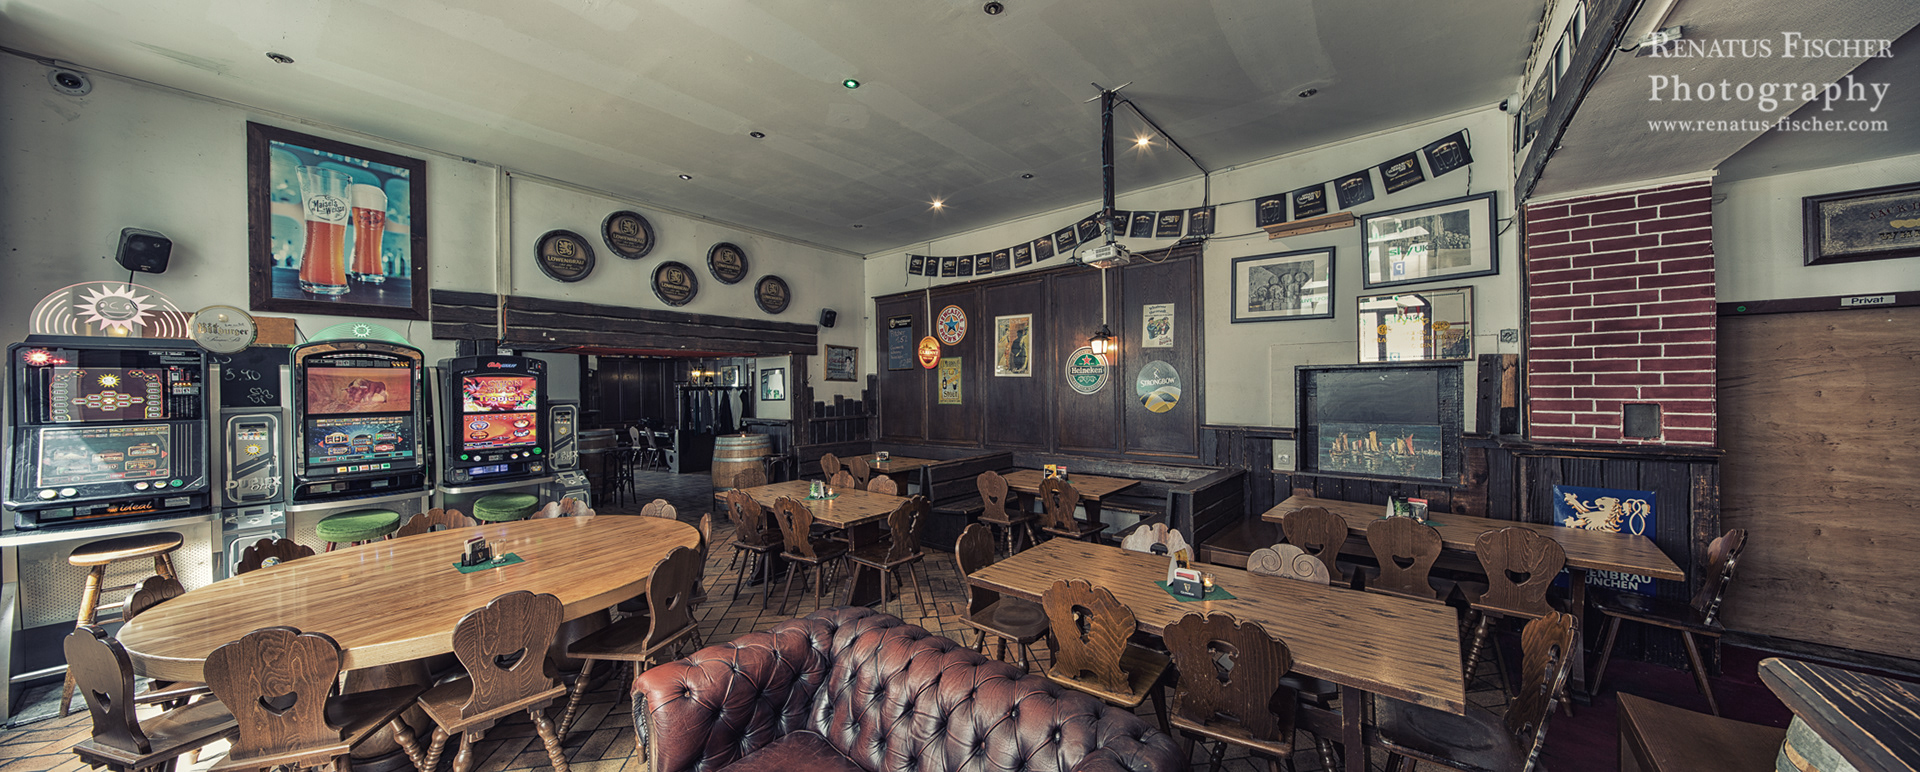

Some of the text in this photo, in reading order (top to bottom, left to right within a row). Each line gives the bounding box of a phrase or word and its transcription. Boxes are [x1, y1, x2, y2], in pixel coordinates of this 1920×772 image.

[1851, 296, 1884, 304] Privat
[940, 309, 964, 325] NEWCASTLE
[197, 322, 248, 336] Bitburger
[1071, 366, 1103, 374] Heineken
[1140, 378, 1175, 388] STRONGBOW
[486, 386, 517, 394] STAR
[479, 394, 525, 403] Tropical
[119, 501, 152, 512] ideal
